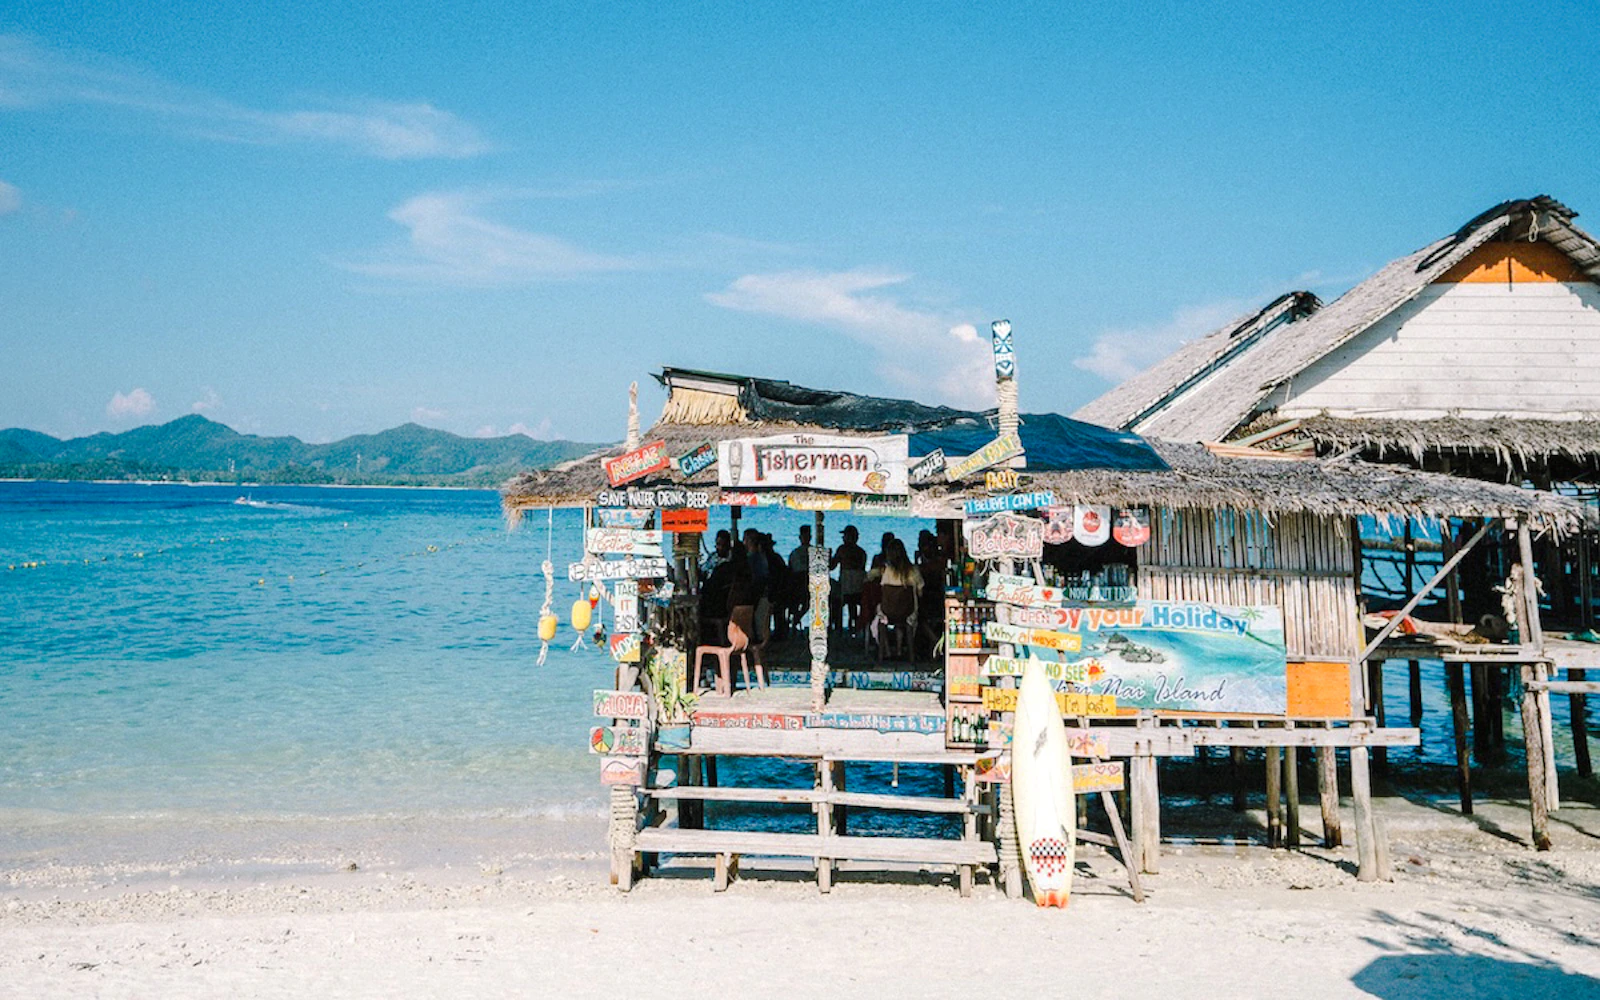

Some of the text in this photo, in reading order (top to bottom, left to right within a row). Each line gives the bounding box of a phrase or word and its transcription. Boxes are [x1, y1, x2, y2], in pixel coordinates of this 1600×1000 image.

[793, 435, 815, 445] The
[985, 434, 1016, 465] BOAT
[752, 444, 868, 481] Fisherman
[793, 473, 817, 484] Bar
[599, 491, 627, 506] SAVE
[628, 491, 656, 507] WATER
[657, 491, 686, 507] DRINK
[686, 491, 709, 508] BEER
[912, 494, 943, 512] Sea
[1012, 494, 1032, 508] CAN
[1034, 490, 1054, 506] FLY
[570, 559, 661, 581] BEACH BAR
[615, 583, 638, 596] TAKE
[620, 600, 632, 611] IT
[1019, 609, 1050, 625] OPEN
[1087, 607, 1146, 633] your
[1152, 605, 1249, 635] Holiday
[988, 623, 1015, 640] Why
[1017, 629, 1057, 648] always
[988, 658, 1016, 675] LONG
[1044, 662, 1063, 680] NO
[1064, 664, 1086, 681] SEE
[850, 671, 870, 688] NO
[892, 671, 911, 689] NO
[1100, 677, 1146, 697] Nai
[1154, 673, 1227, 702] Island
[603, 693, 645, 716] ALOHA
